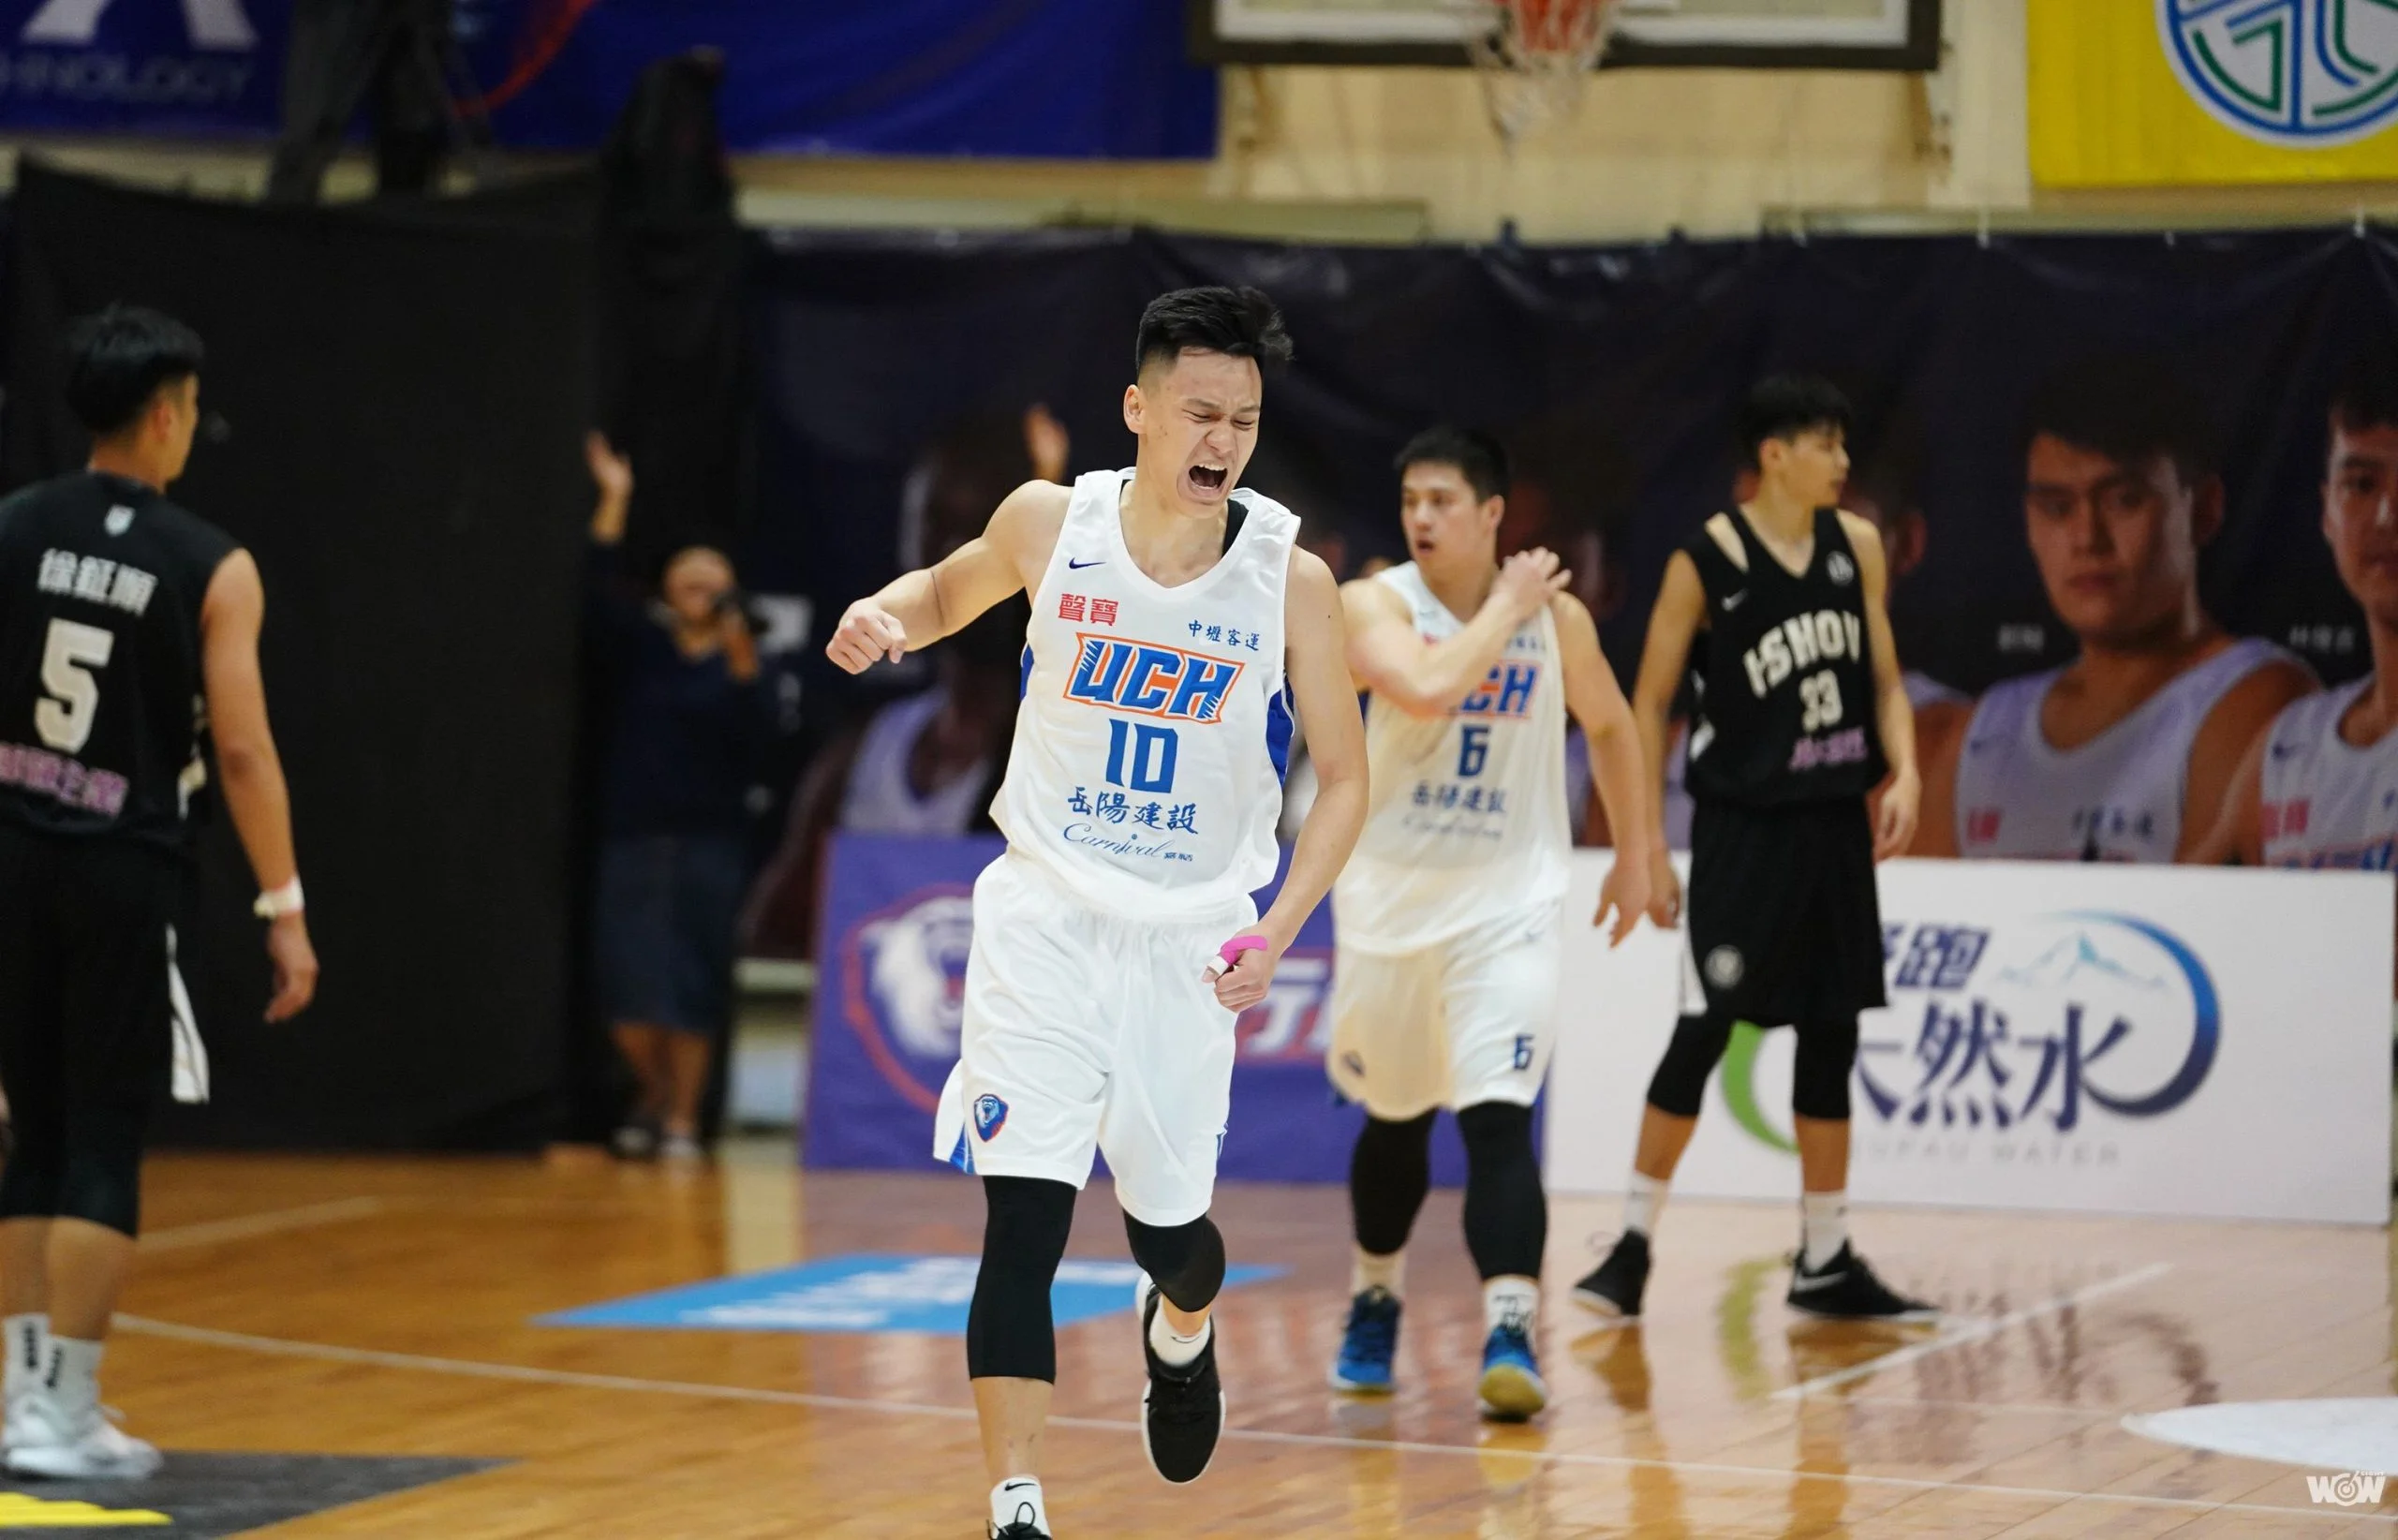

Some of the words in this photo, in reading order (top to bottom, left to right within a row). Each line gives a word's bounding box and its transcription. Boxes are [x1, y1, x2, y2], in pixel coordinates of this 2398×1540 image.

[1058, 593, 1119, 627] 聲寶
[1188, 619, 1260, 651] 中壢客運
[34, 618, 114, 754] 5
[1069, 637, 1237, 723] UCH
[1448, 663, 1538, 714] CH
[1798, 669, 1844, 733] 33
[1105, 718, 1179, 794] 10
[1458, 724, 1491, 777] 6
[1066, 786, 1200, 836] 岳陽建設
[1063, 822, 1176, 858] Carnival
[1513, 1034, 1535, 1071] 6
[1991, 1139, 2120, 1167] WATER
